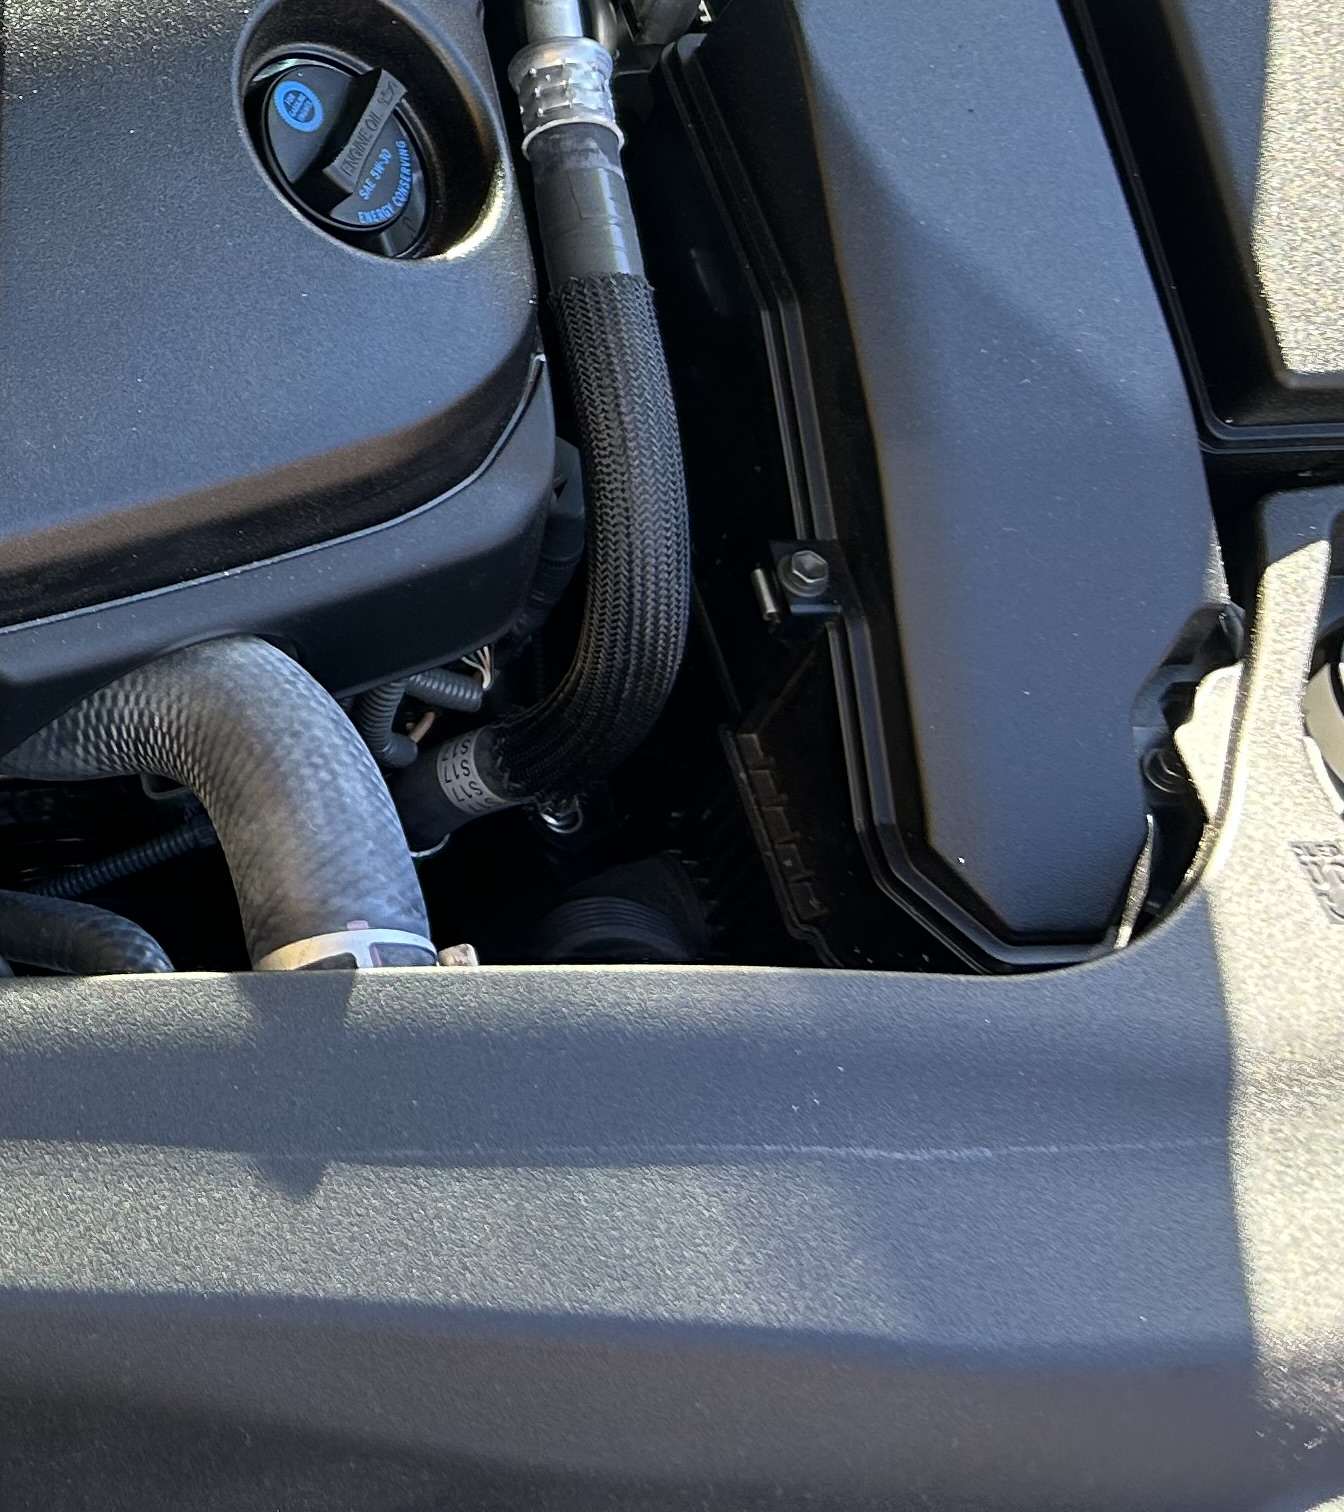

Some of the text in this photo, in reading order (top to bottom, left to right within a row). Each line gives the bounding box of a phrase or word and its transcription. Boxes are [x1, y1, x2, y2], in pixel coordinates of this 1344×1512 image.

[340, 110, 382, 177] ENGINE OIL
[357, 140, 412, 224] ENERGY CONSERVING
[358, 148, 392, 201] SAE 5W-30
[444, 759, 471, 784] S17
[452, 780, 484, 802] S17
